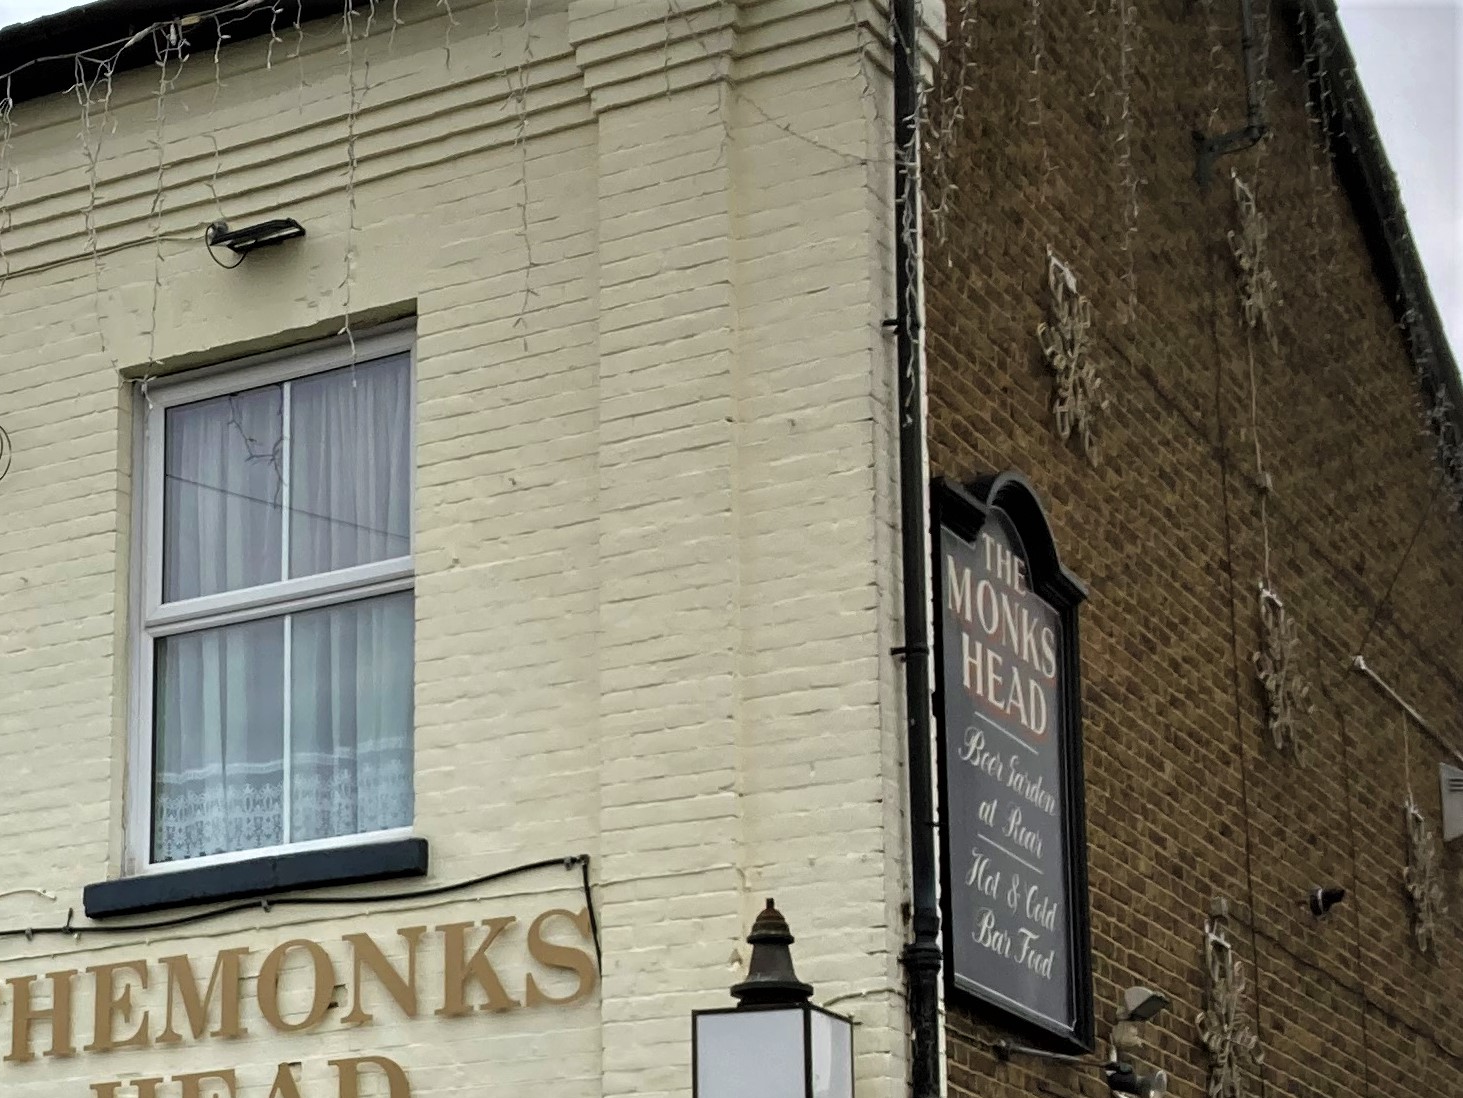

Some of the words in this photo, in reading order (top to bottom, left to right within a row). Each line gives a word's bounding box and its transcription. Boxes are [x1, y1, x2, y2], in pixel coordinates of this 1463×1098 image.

[982, 533, 1026, 595] THE
[946, 554, 1056, 679] MONKS
[962, 631, 1047, 735] HEAD
[958, 726, 1003, 782] Beer
[1006, 755, 1057, 817] Garden
[978, 799, 998, 828] at
[1002, 805, 1044, 859] Rear
[965, 846, 1001, 900] Hot
[1007, 873, 1021, 914] &
[1026, 884, 1057, 932] Cold
[972, 906, 1011, 958] Bar
[1014, 927, 1056, 980] Food
